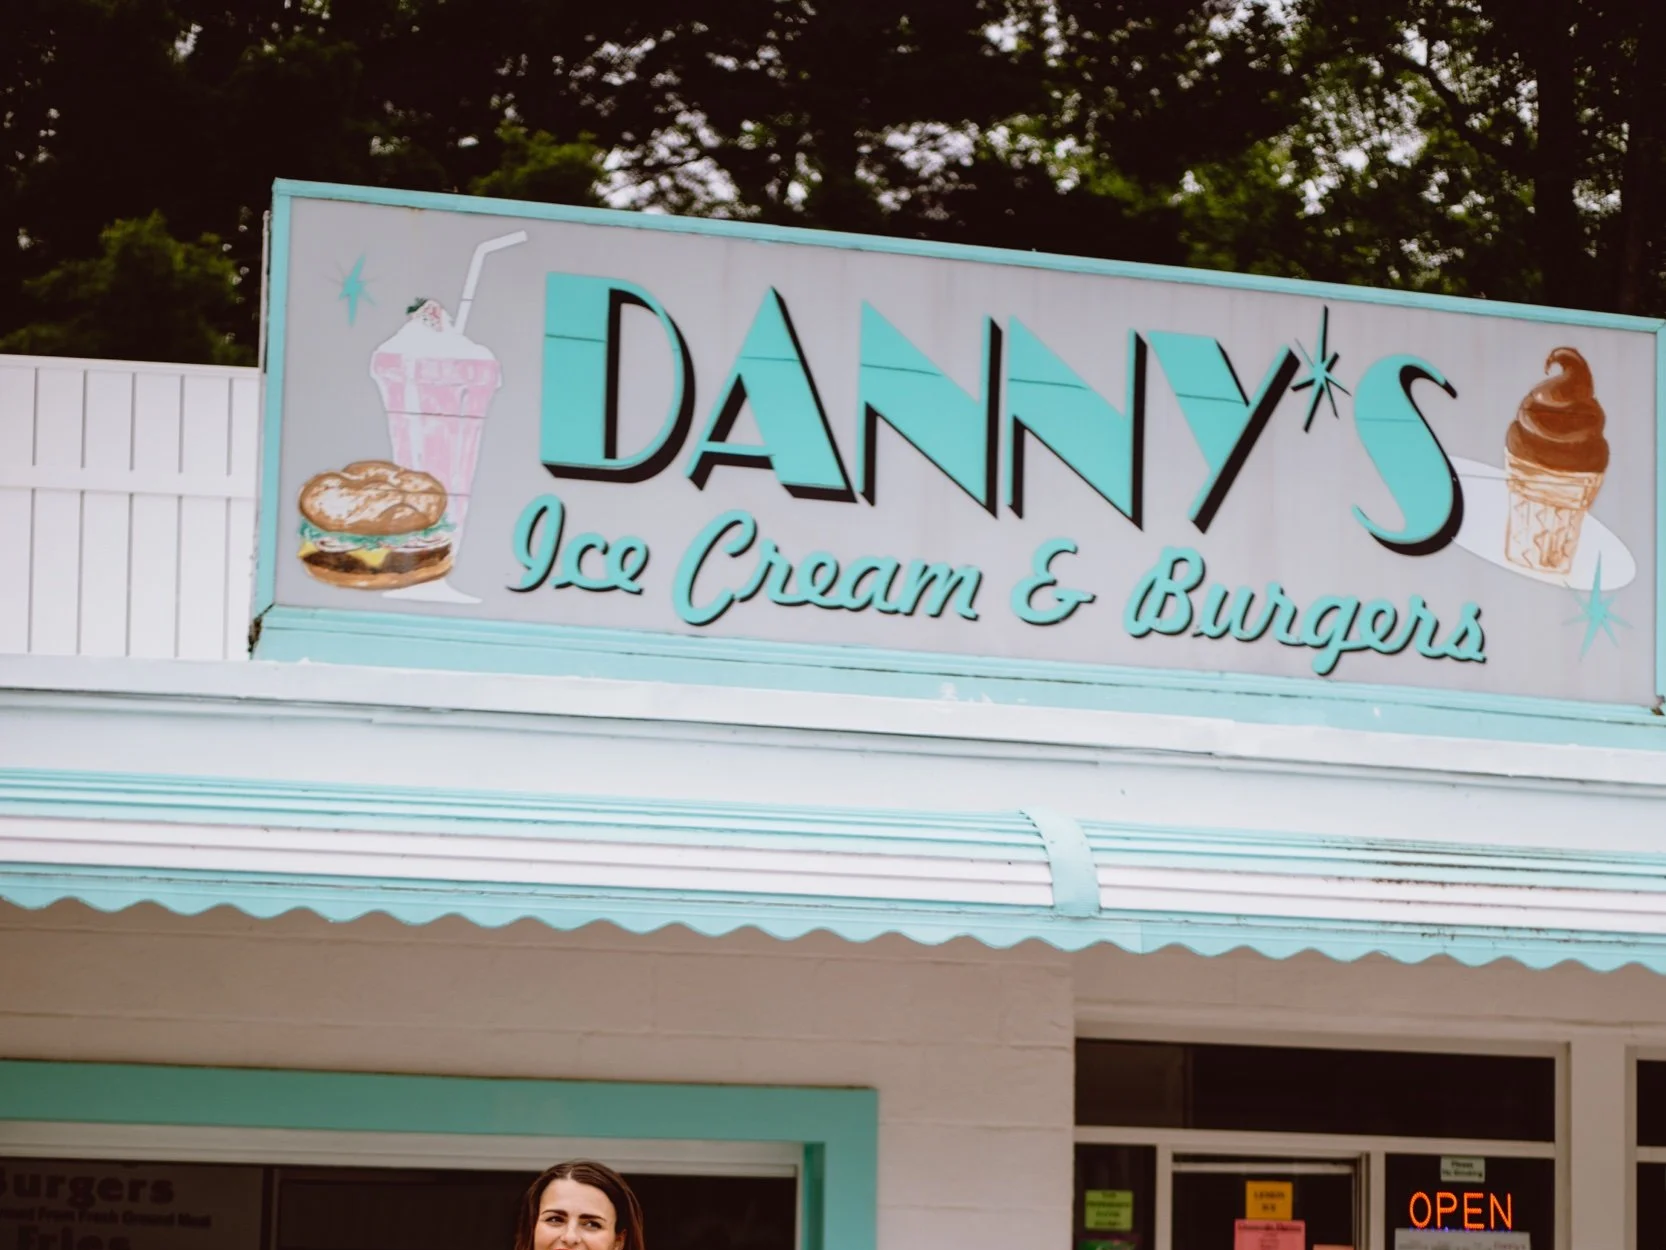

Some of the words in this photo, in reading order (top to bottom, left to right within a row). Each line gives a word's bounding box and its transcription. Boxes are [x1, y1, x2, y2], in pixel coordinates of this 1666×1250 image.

[540, 272, 1464, 556] DANNY'S
[507, 493, 650, 596] Ice
[672, 509, 979, 627] Cream
[1010, 537, 1096, 626] &
[1125, 546, 1487, 676] Burgers
[1409, 1191, 1512, 1229] OPEN
